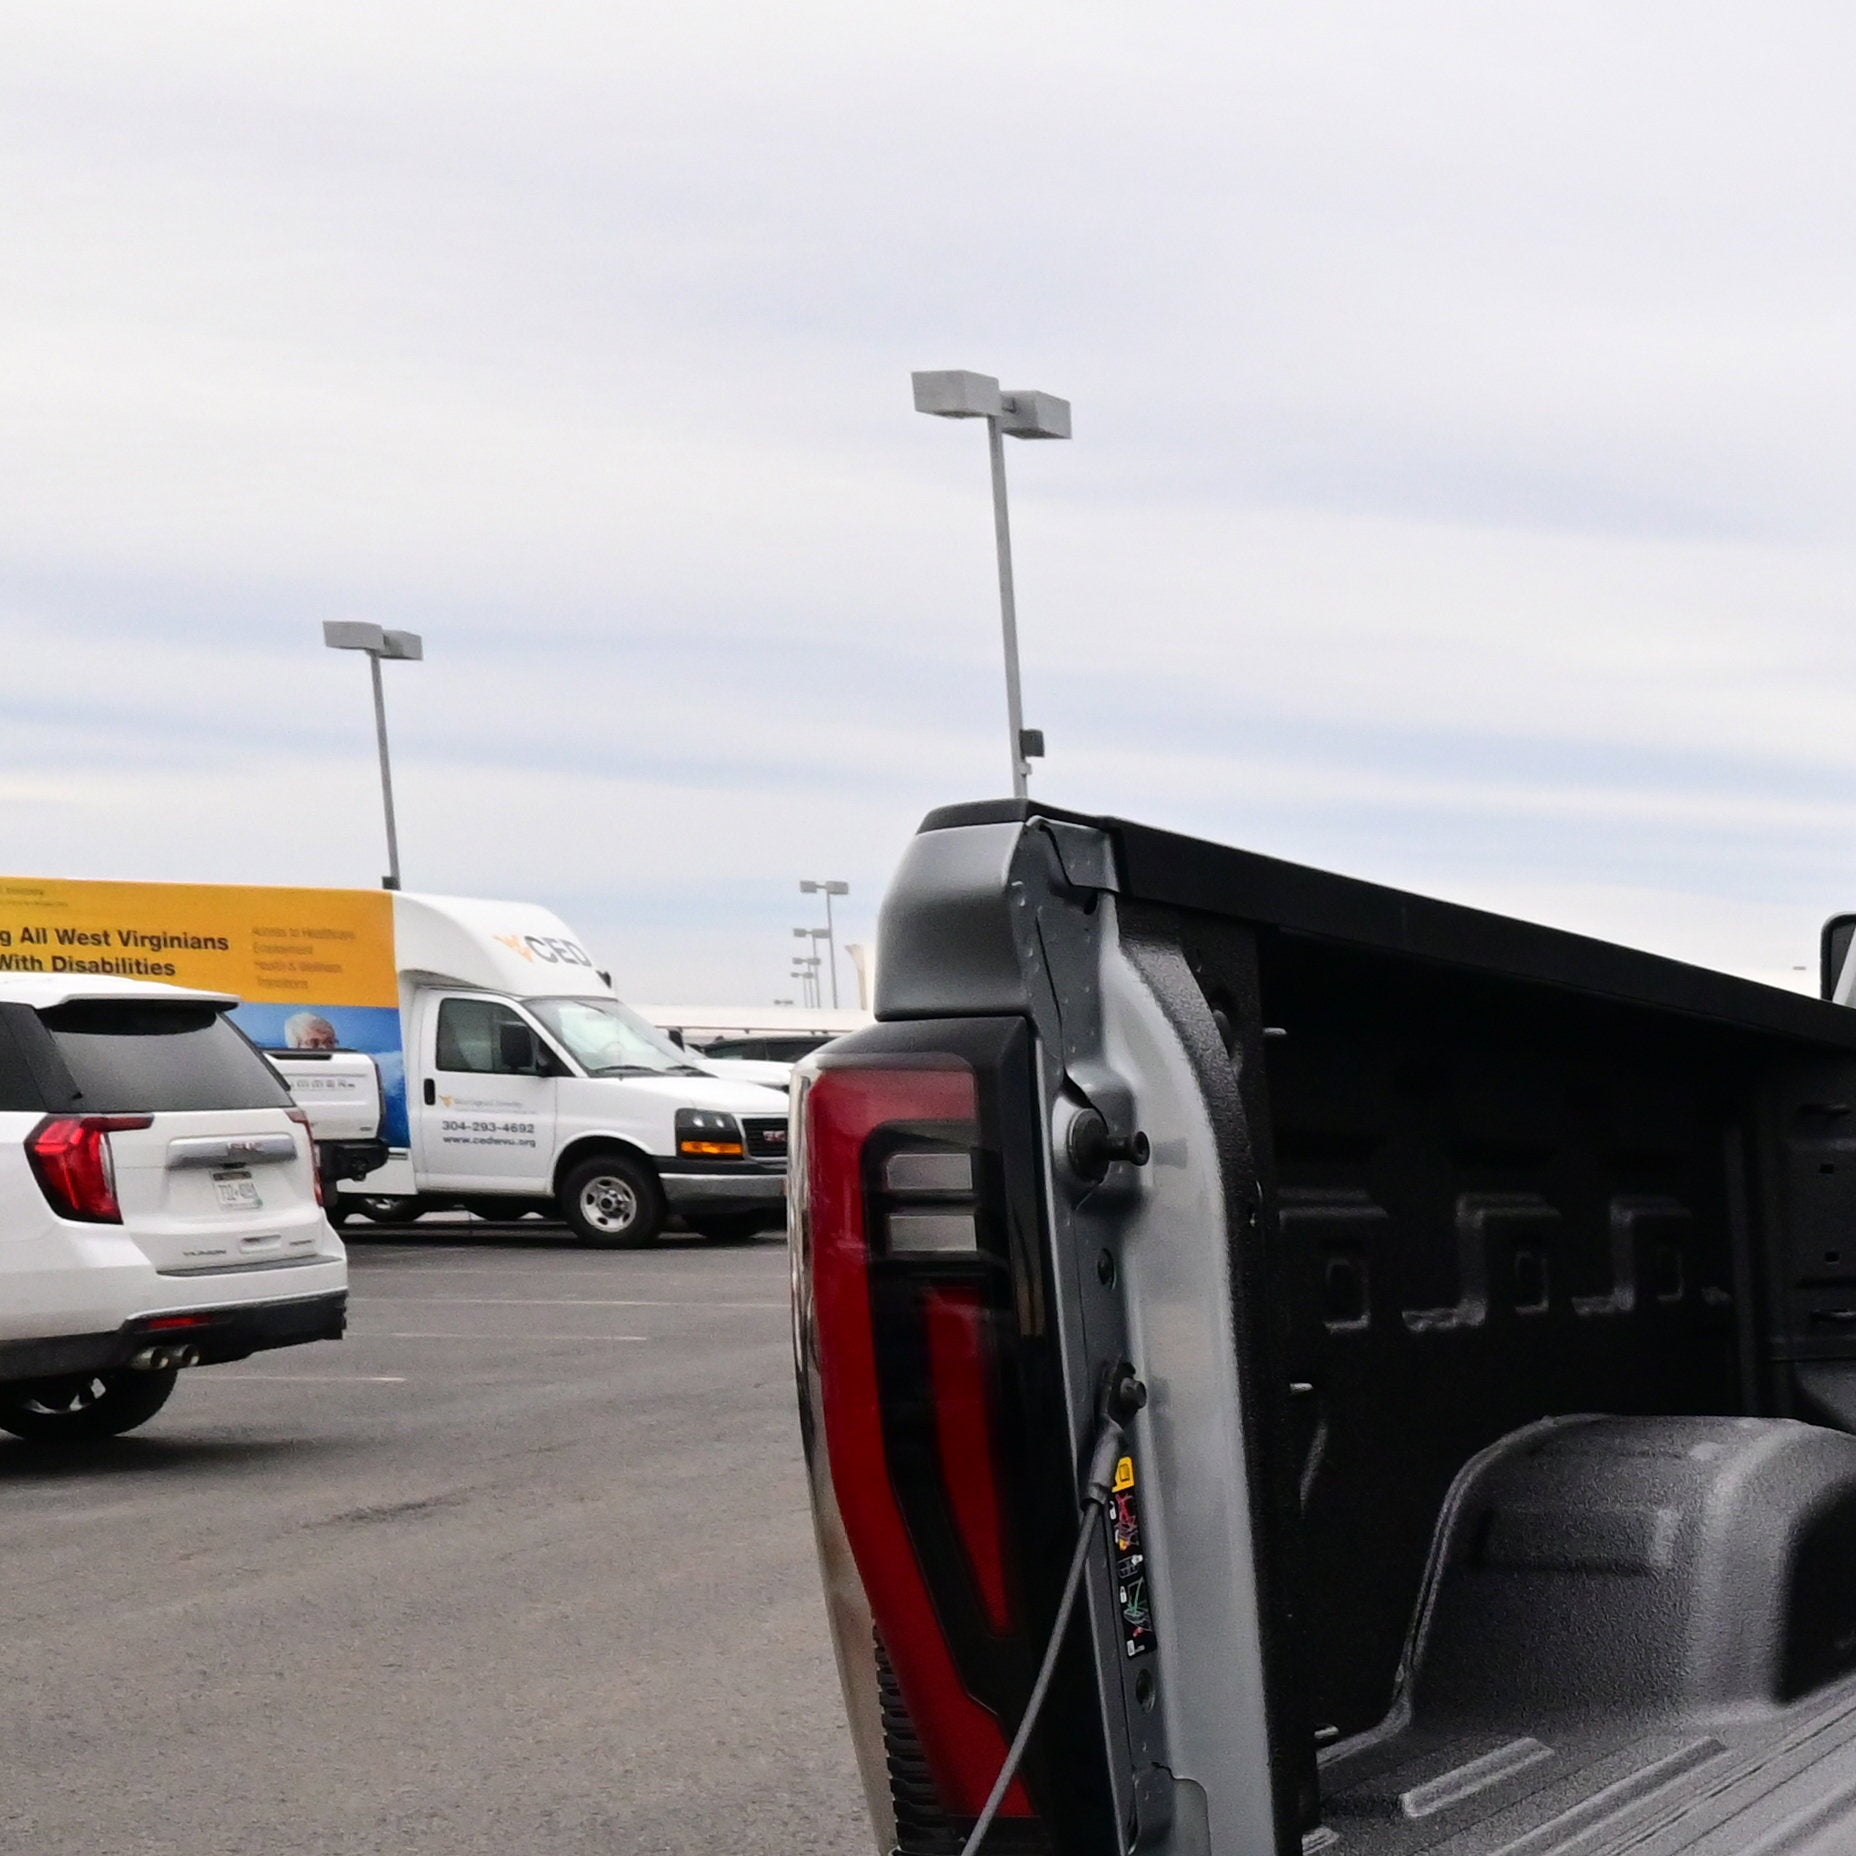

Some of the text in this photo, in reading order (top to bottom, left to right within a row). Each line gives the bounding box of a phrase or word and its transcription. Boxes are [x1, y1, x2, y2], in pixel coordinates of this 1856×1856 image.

[20, 926, 48, 945] All
[54, 928, 111, 947] West
[117, 929, 230, 952] Virginians
[523, 935, 593, 968] CED
[51, 955, 177, 976] Disabilities
